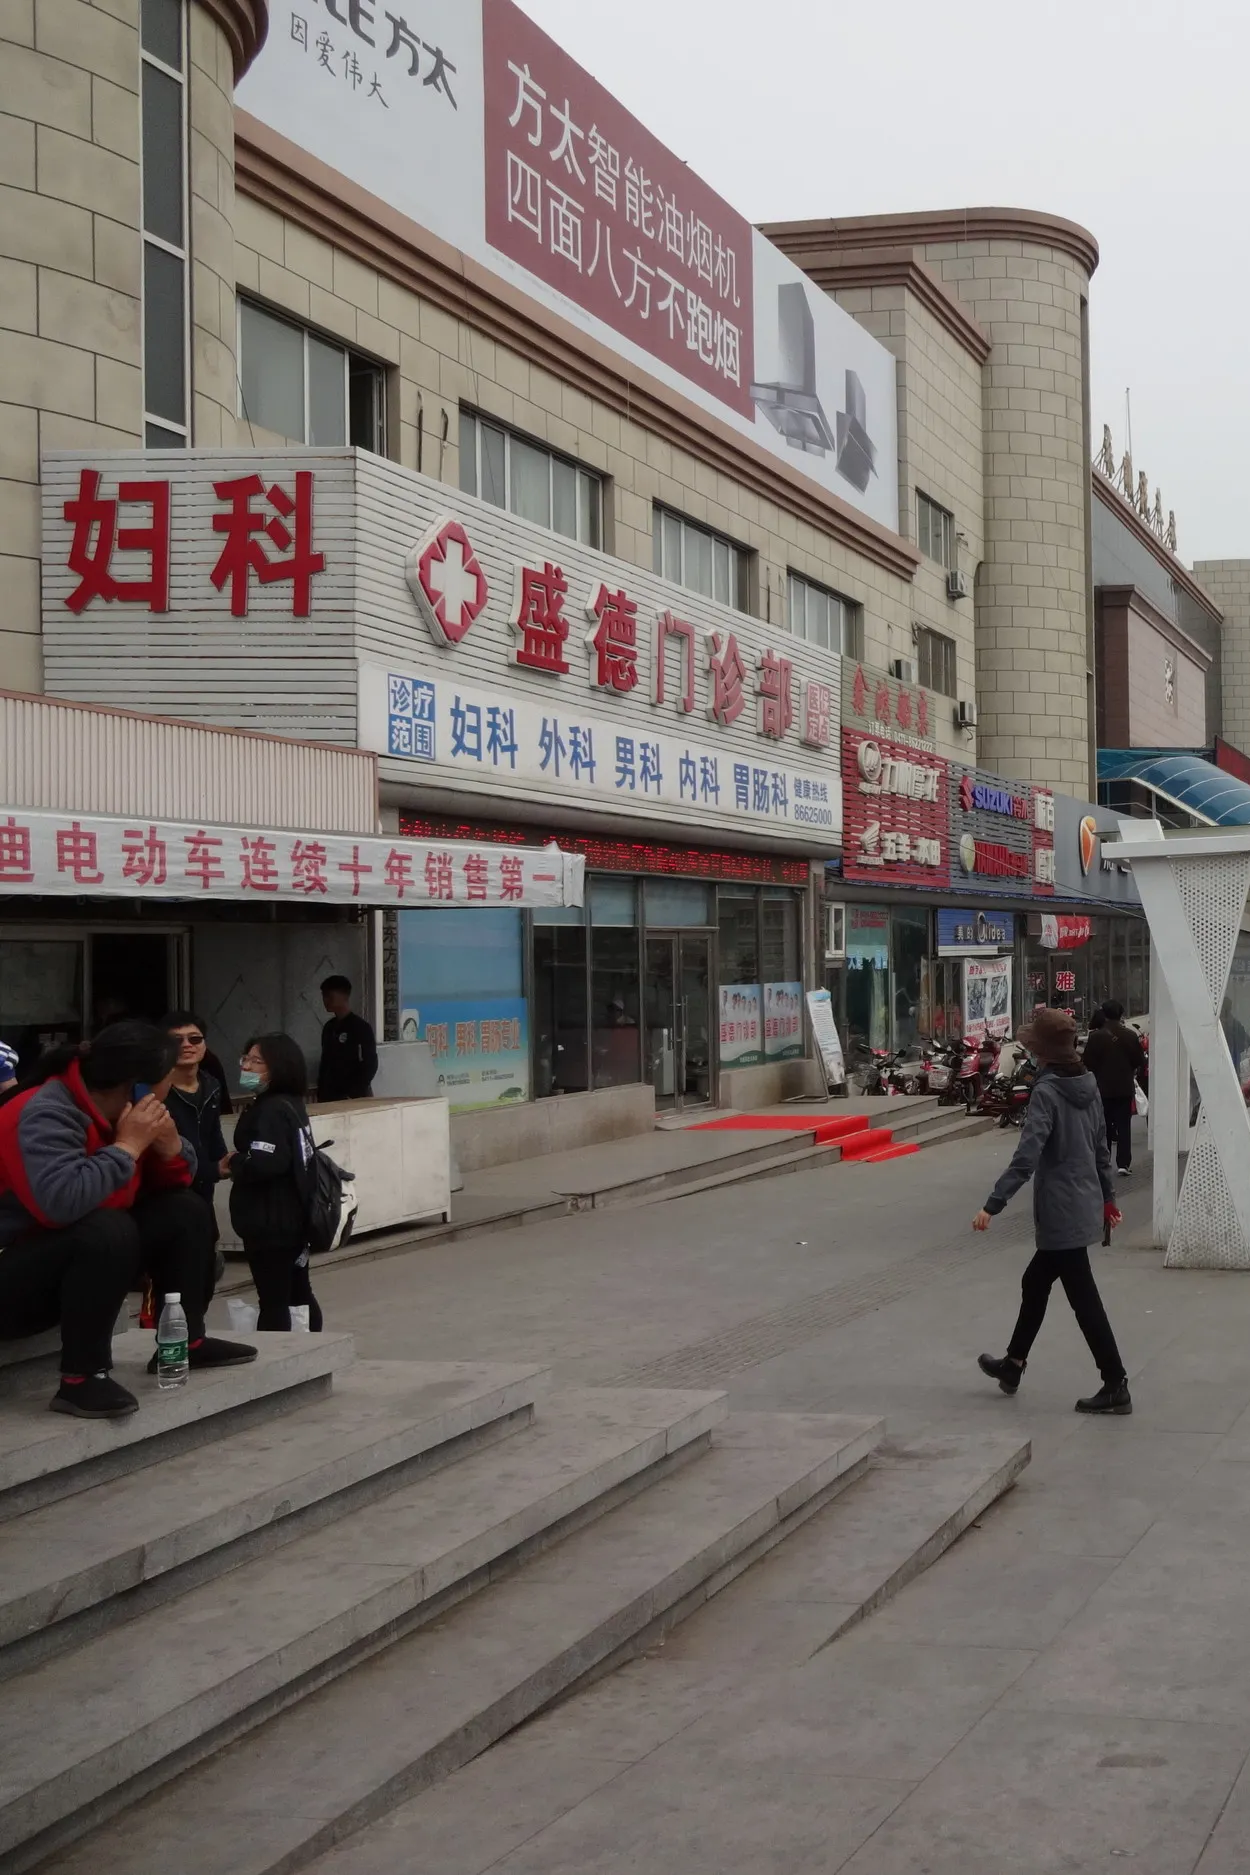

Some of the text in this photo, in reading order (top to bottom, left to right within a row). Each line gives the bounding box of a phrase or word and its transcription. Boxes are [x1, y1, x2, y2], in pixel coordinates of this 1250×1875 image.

[291, 12, 389, 109] 因爱伟大
[507, 59, 741, 308] 方太智能油烟机
[506, 149, 741, 388] 四面八方不跑烟
[63, 469, 326, 617] 妇科
[510, 560, 794, 739] 盛德门诊部
[390, 678, 435, 719] 诊疗
[390, 718, 434, 757] 范围
[450, 695, 789, 817] 妇科 外科 男科 内科 胃肠科
[974, 785, 1013, 816] SUZUKI
[0, 816, 556, 900] 迪电动车连续十年销售第一
[793, 803, 833, 826] 86625000
[1056, 970, 1075, 991] 雅
